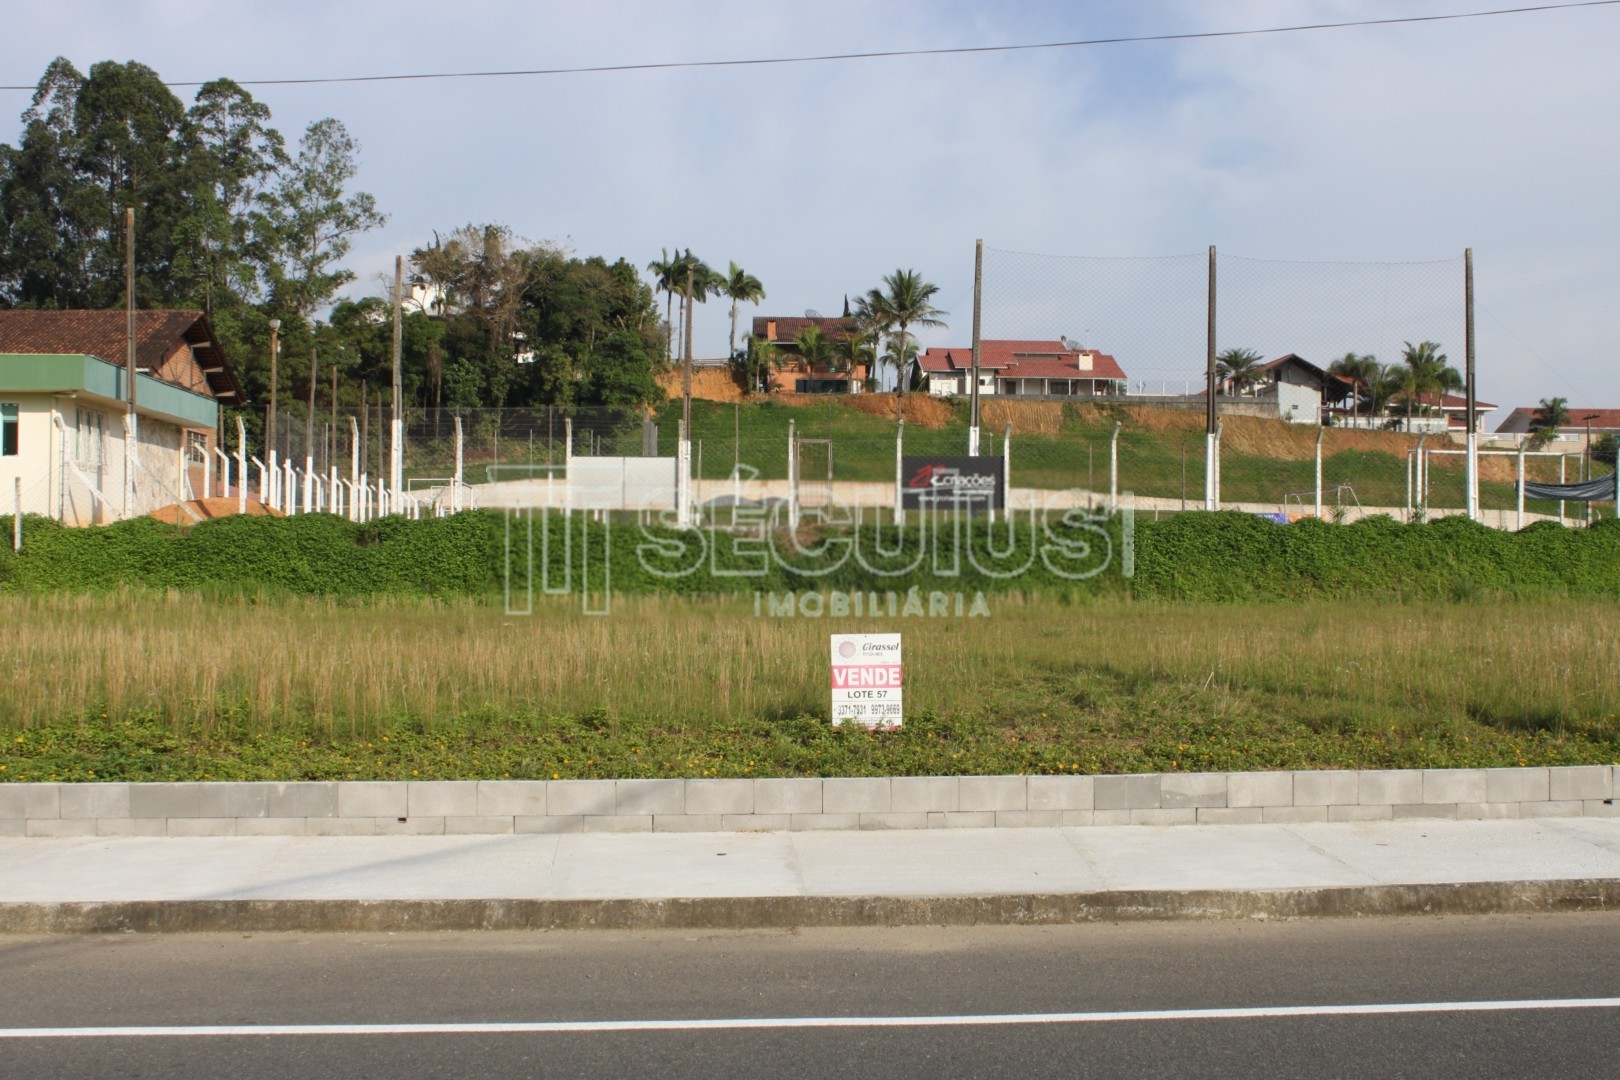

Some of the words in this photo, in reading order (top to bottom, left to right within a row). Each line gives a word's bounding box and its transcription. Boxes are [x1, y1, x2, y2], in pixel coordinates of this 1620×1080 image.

[862, 642, 899, 651] Girassol
[833, 668, 900, 686] VENDE
[847, 690, 874, 699] LOTE
[876, 690, 888, 698] 57
